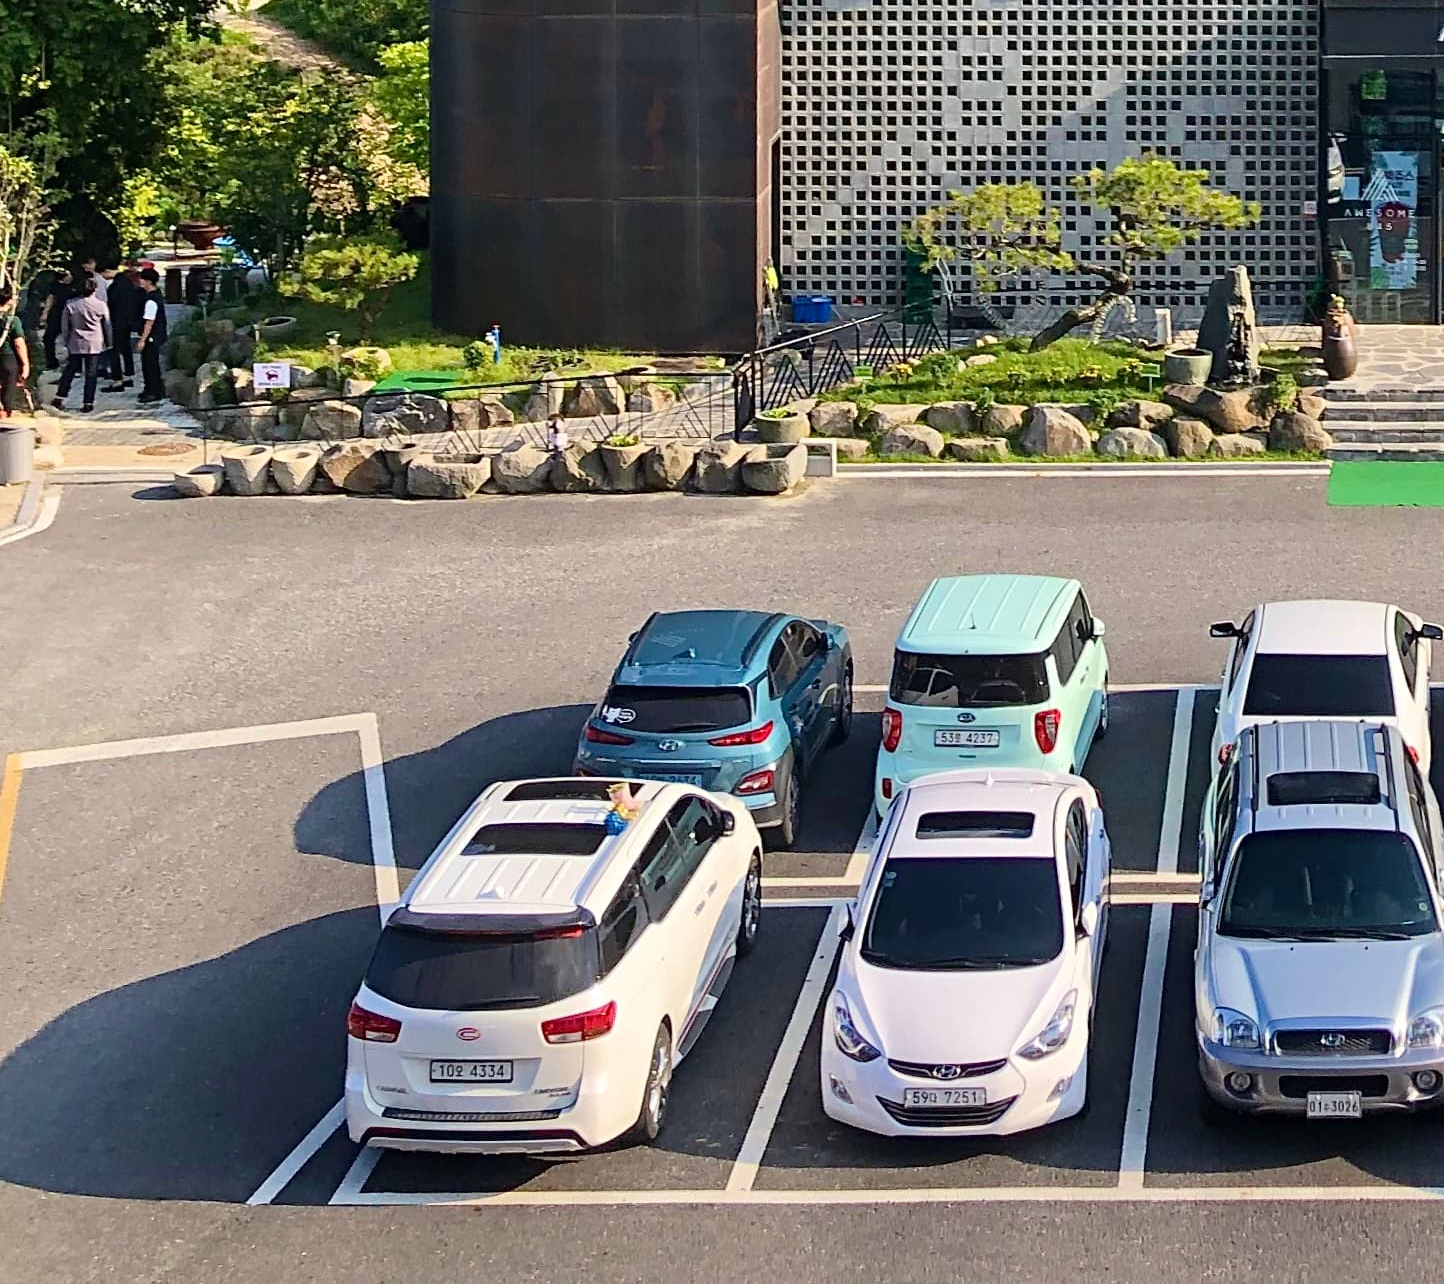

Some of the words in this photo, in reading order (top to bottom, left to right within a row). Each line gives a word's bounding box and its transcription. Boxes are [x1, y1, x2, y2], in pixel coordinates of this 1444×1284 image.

[1343, 208, 1416, 218] AWESOME
[965, 733, 993, 744] 4237
[439, 1065, 463, 1078] 10오
[469, 1065, 505, 1079] 4334
[912, 1091, 938, 1104] 59마
[944, 1091, 977, 1104] 7251
